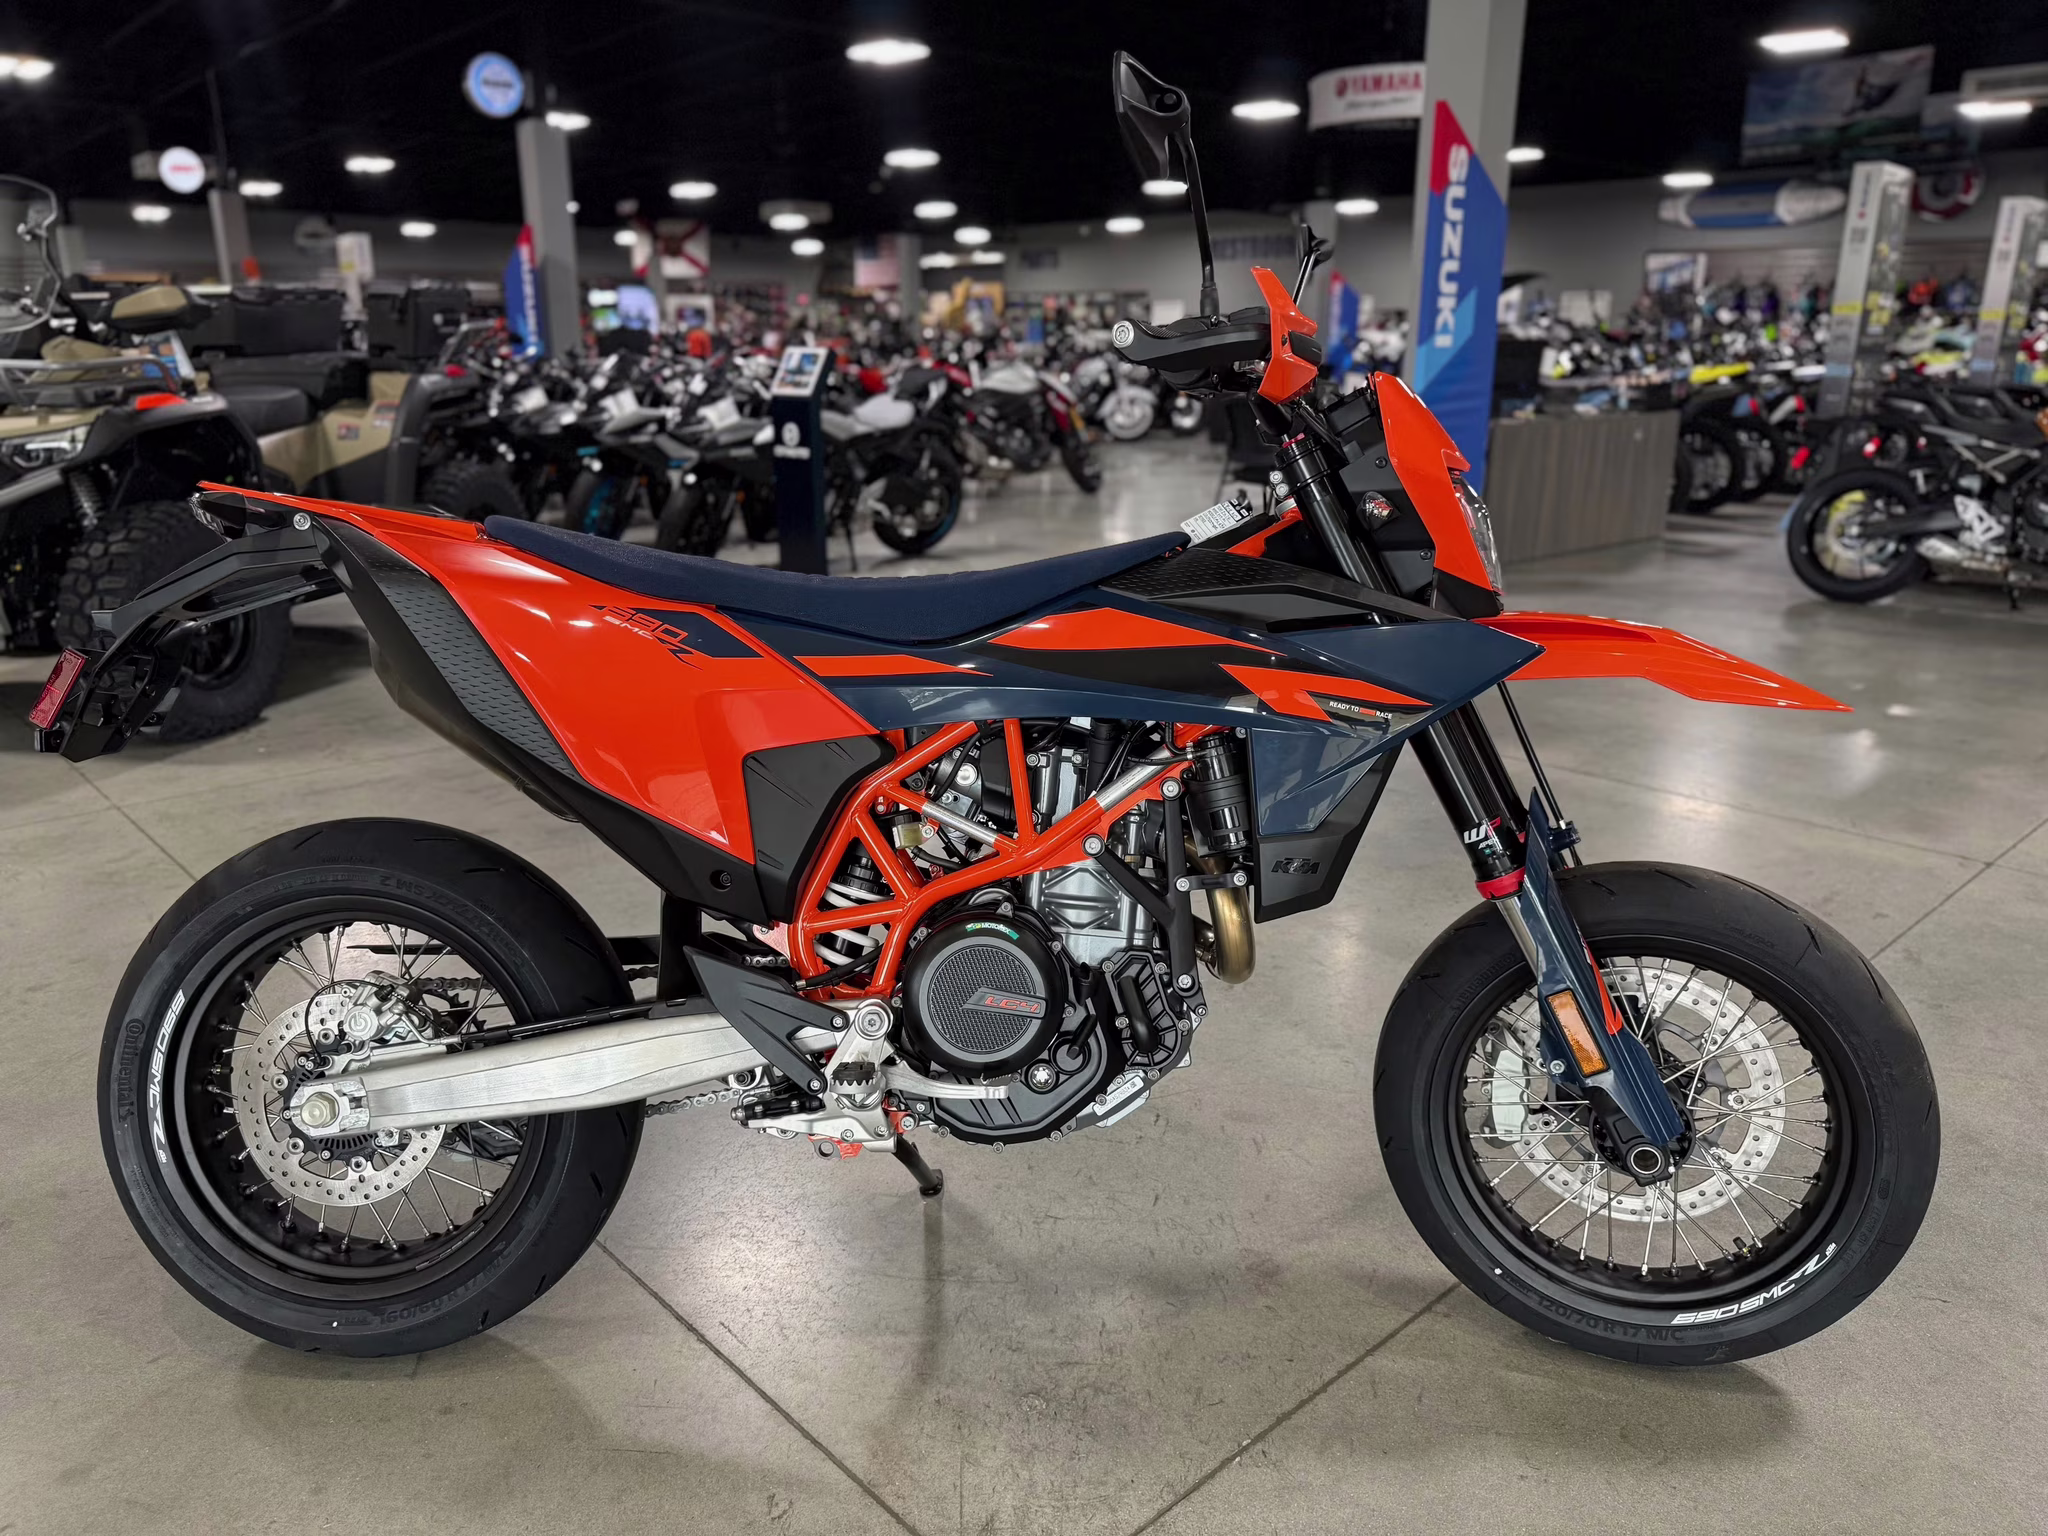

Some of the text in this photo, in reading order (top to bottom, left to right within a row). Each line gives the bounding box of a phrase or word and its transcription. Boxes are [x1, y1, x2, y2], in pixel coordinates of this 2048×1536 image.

[1352, 72, 1423, 94] YAMAHA
[1434, 143, 1470, 348] SUZUKI
[1329, 701, 1351, 710] READY
[1376, 710, 1393, 719] RACE
[1271, 857, 1321, 875] KTM
[981, 922, 1011, 935] MOTOREX
[984, 996, 1041, 1013] LC4
[117, 1018, 146, 1109] Continental
[1536, 1291, 1599, 1331] 120/70
